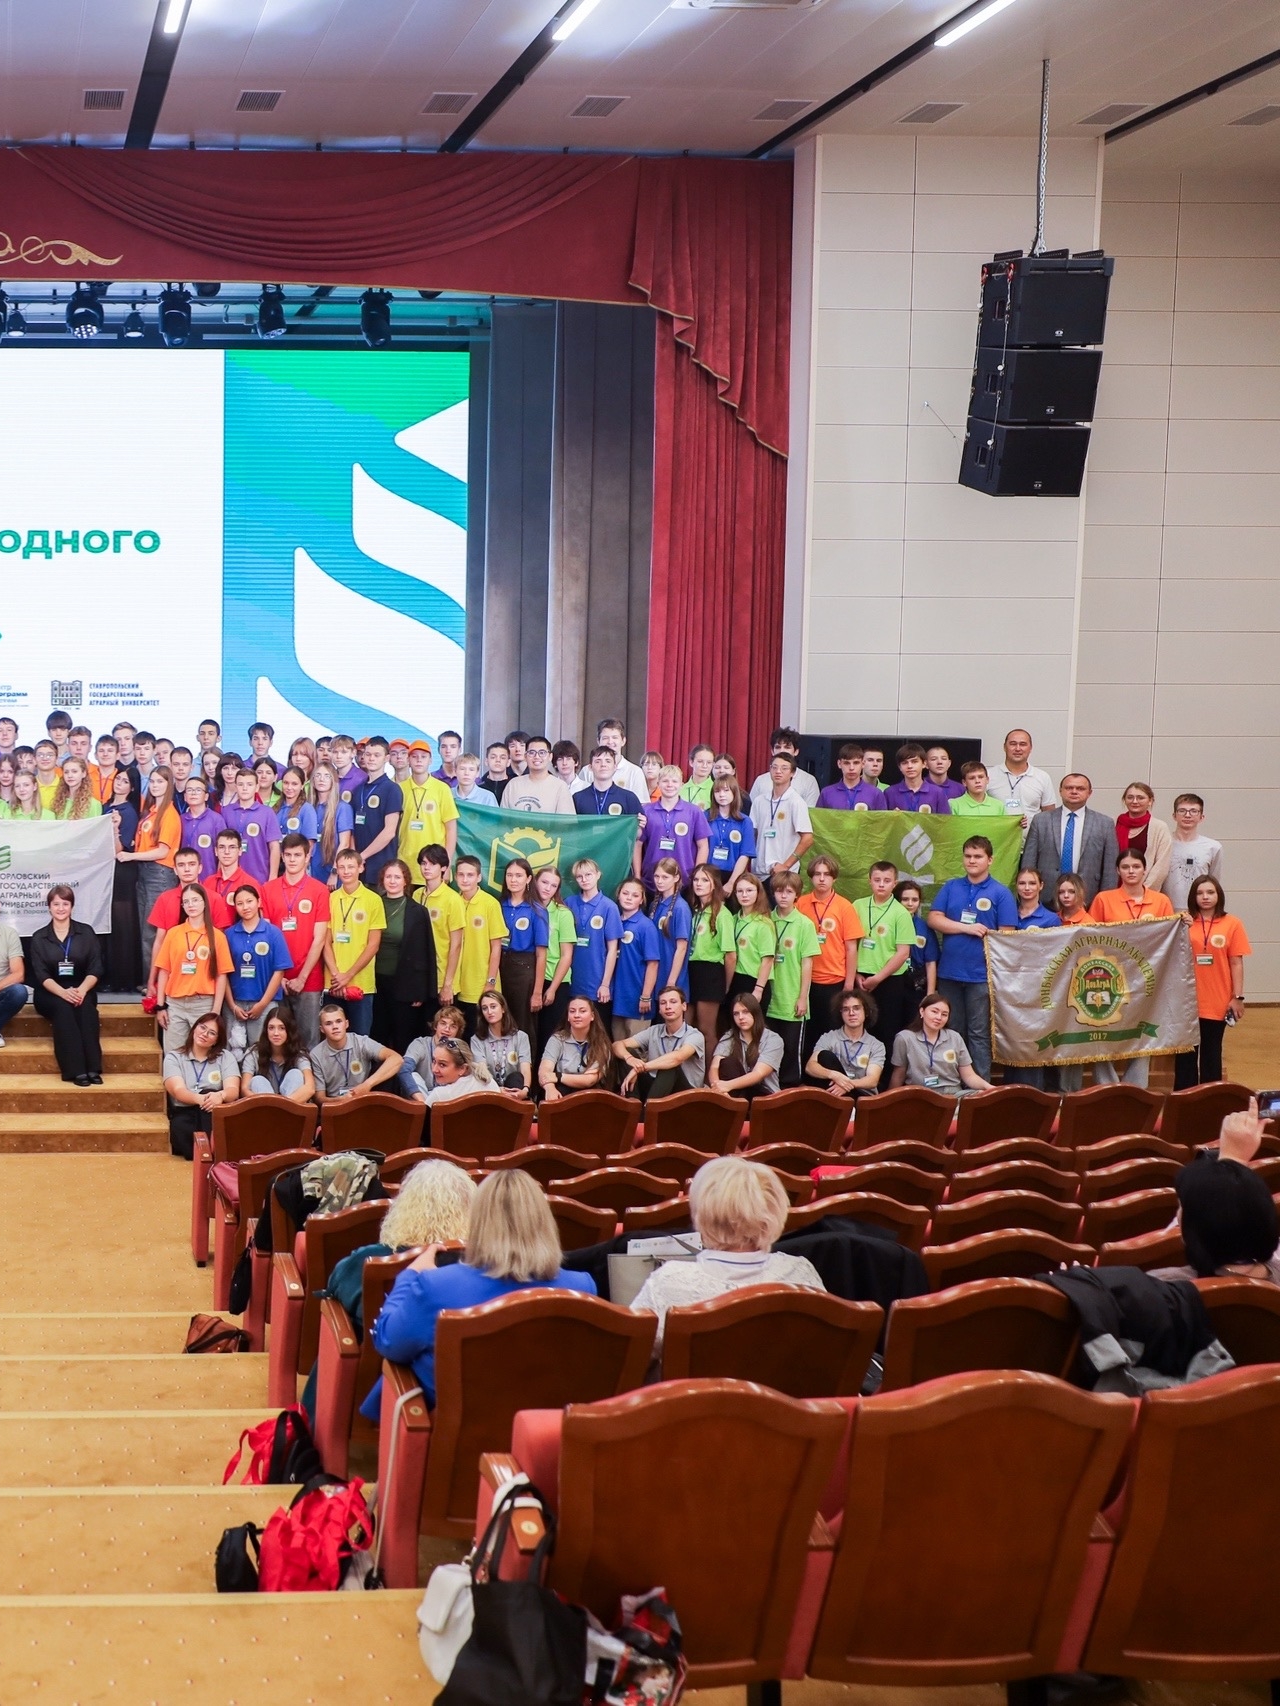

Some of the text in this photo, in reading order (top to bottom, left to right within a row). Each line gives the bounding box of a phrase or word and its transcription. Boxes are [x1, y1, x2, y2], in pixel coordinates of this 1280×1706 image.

[89, 690, 144, 698] ГОСУДАРСТВЕННЫЙ
[0, 872, 51, 880] ОРЛОВСКИЙ
[0, 890, 42, 899] АГРАРНЫЙ
[1080, 960, 1115, 973] ДОНБАССКАЯ
[1040, 934, 1156, 1010] ДОНБАССКАЯ АГРАРНАЯ АКАДЕМИЯ
[1088, 1032, 1108, 1041] 2017
